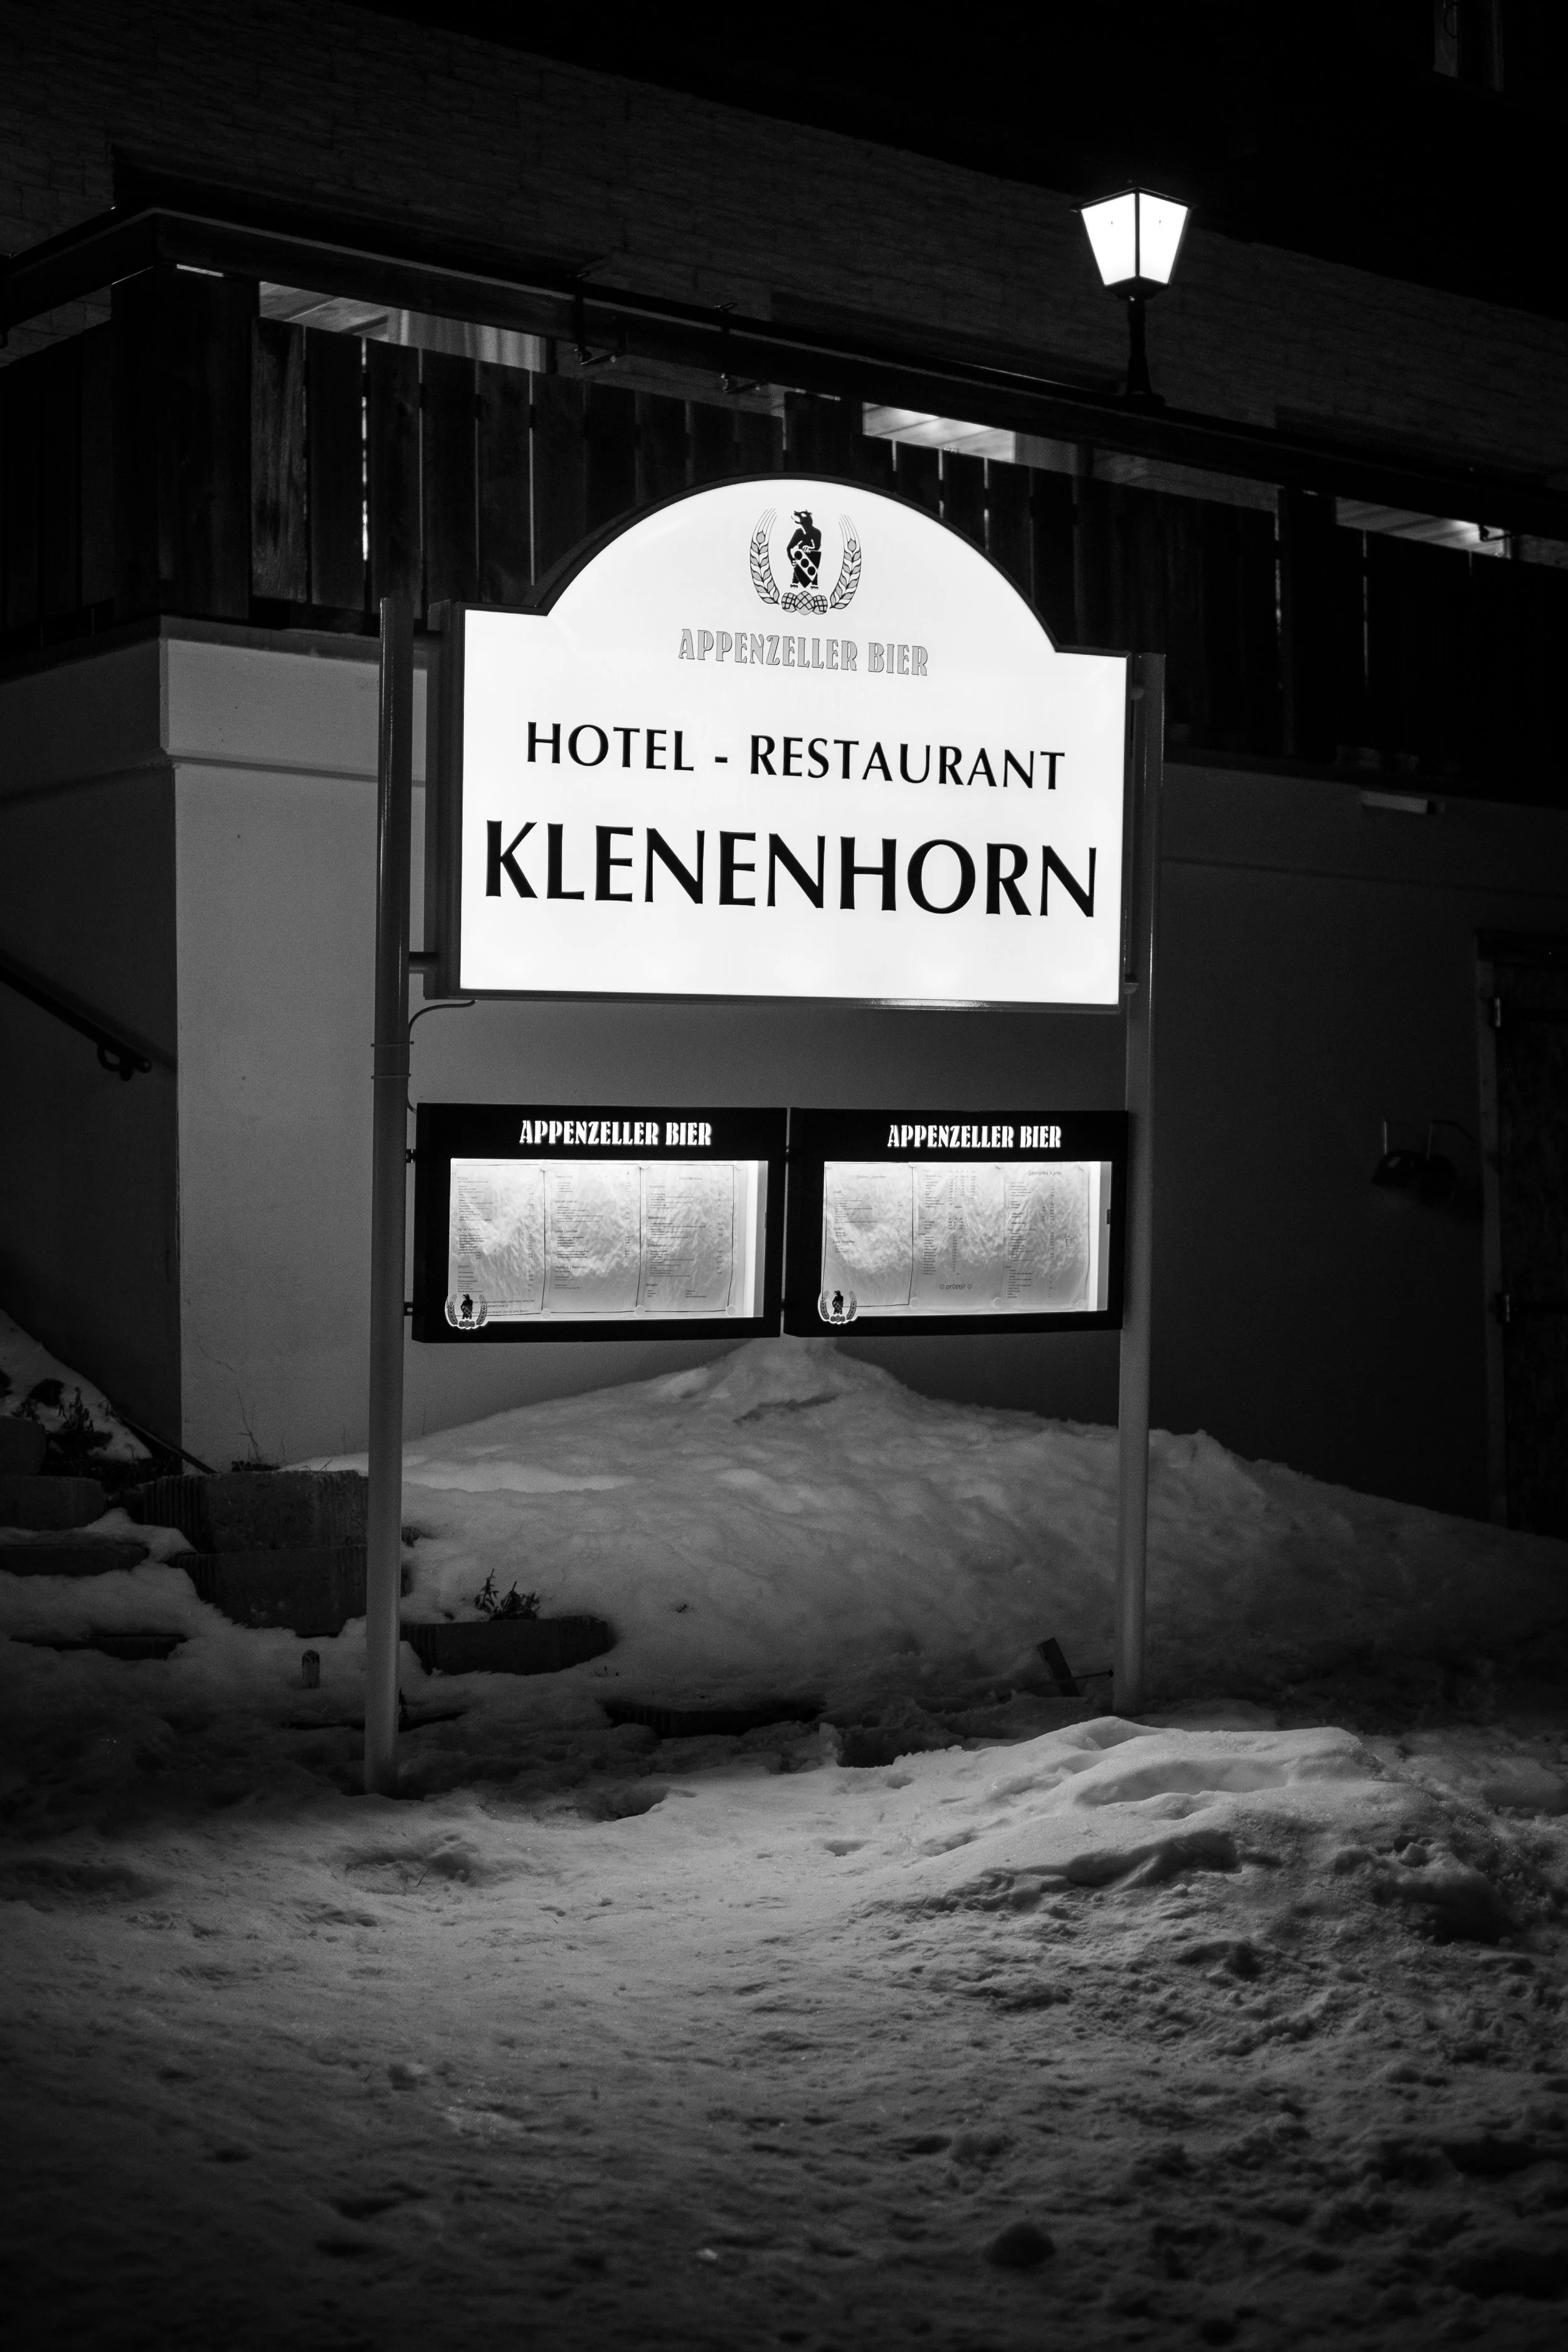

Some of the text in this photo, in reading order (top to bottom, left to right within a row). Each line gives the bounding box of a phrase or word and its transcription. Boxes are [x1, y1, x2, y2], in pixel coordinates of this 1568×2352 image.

[677, 628, 928, 677] APPENZELLER BIER
[527, 721, 694, 771] HOTEL
[750, 734, 1066, 790] RESTAURANT
[485, 820, 1097, 918] KLENENHORN
[519, 1120, 712, 1146] APPENZELLER BIER
[887, 1125, 1062, 1148] APPENZELLER BIER
